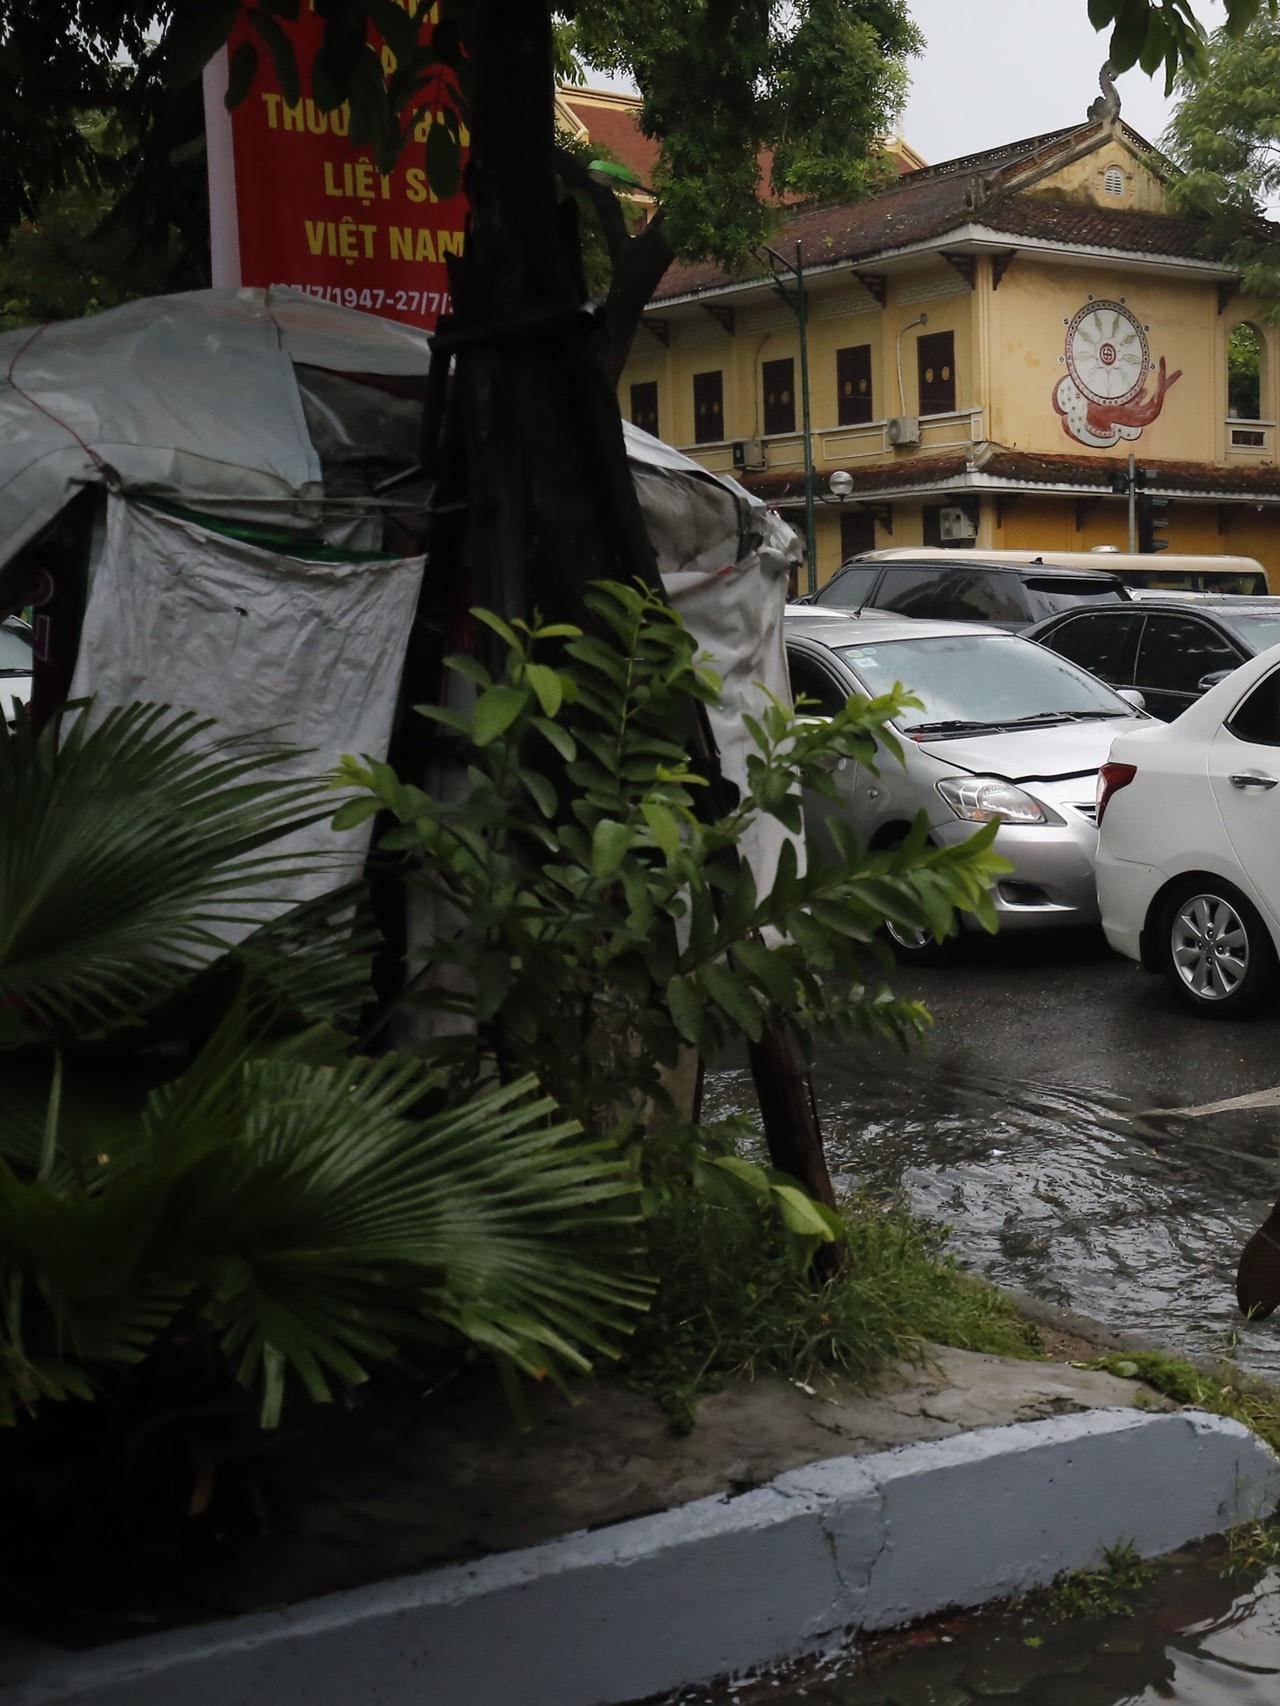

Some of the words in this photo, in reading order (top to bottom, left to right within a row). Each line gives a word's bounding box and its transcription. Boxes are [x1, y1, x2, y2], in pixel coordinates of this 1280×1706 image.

[323, 156, 391, 206] LIỆT
[304, 215, 378, 265] VIỆT
[388, 226, 465, 263] NAM
